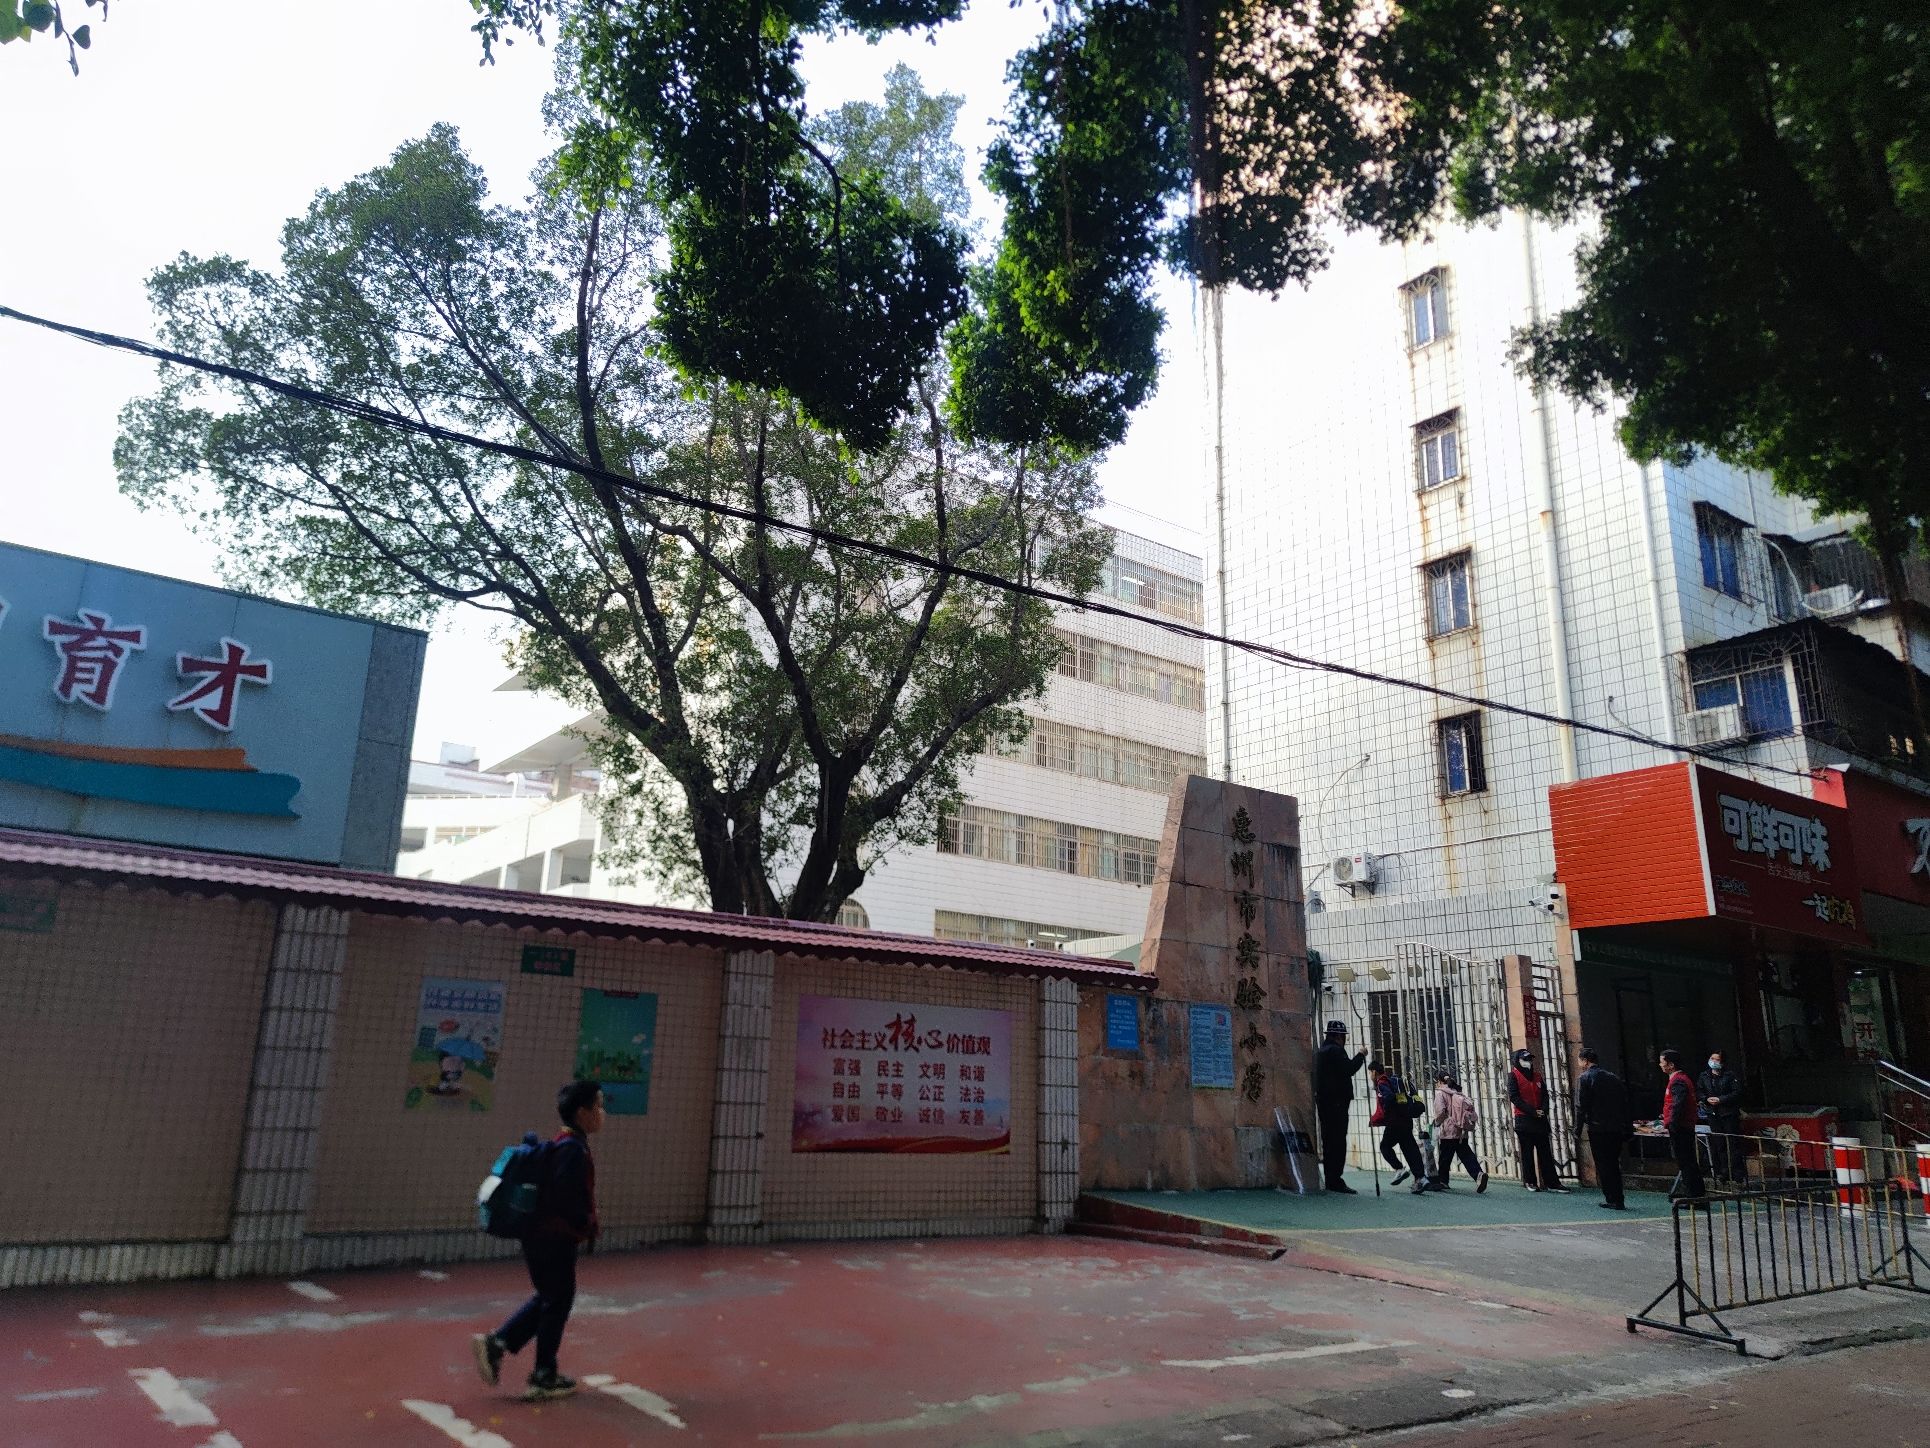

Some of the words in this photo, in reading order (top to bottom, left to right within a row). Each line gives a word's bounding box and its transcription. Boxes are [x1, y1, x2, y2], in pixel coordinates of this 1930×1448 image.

[0, 594, 273, 731] 育才
[821, 1012, 991, 1056] 社会主义核心价值观
[833, 1057, 861, 1076] 富强
[877, 1060, 904, 1078] 民主
[918, 1062, 946, 1080] 文明
[959, 1064, 985, 1082] 和谐
[832, 1081, 860, 1099] 自由
[876, 1083, 904, 1101] 平等
[918, 1085, 945, 1102] 公正
[959, 1086, 985, 1104] 法治
[832, 1104, 860, 1123] 爱国
[875, 1105, 903, 1123] 敬业
[918, 1106, 945, 1124] 诚信
[959, 1108, 985, 1126] 友善
